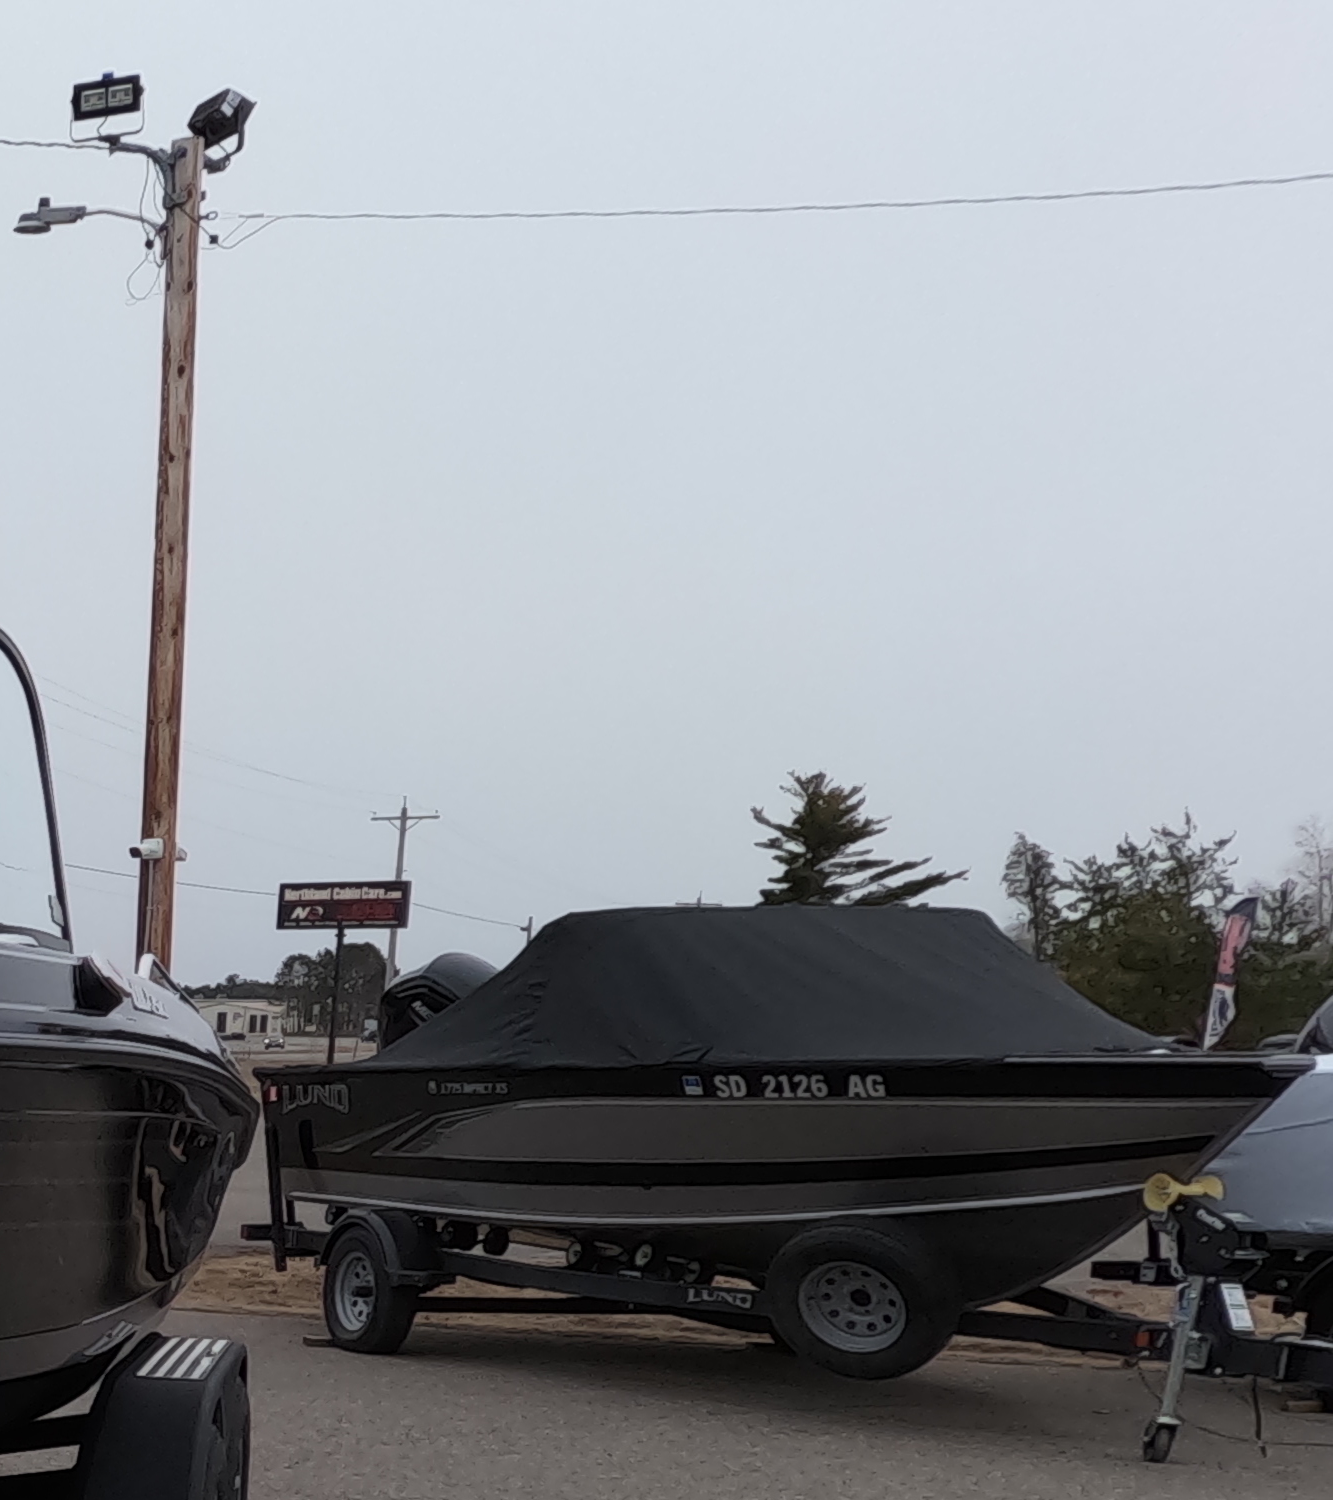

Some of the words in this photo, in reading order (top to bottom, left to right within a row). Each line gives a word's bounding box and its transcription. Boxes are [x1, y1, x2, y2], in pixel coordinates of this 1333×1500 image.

[282, 1084, 350, 1114] LUND
[713, 1074, 748, 1098] SD
[761, 1074, 829, 1099] 2126
[848, 1074, 887, 1098] AG
[686, 1287, 753, 1309] LUND
